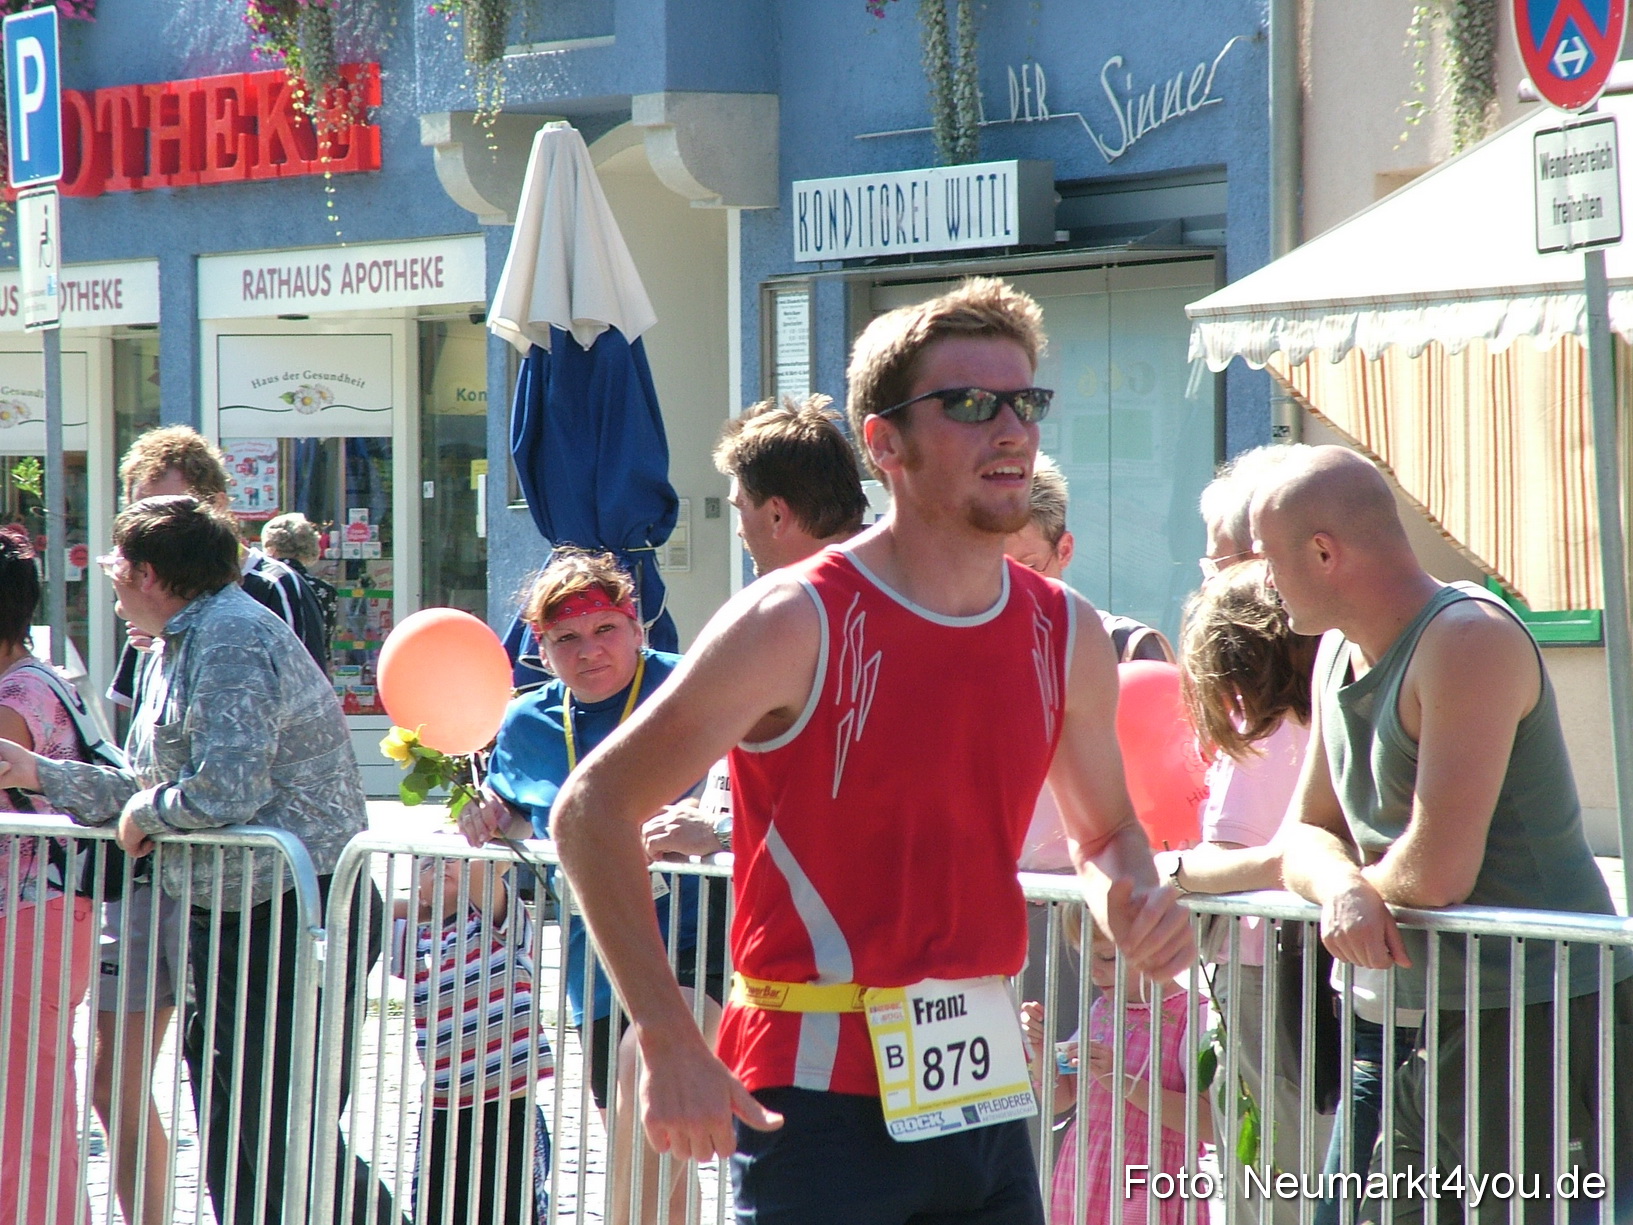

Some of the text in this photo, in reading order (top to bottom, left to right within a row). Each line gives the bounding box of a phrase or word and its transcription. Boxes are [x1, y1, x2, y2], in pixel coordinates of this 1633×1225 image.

[16, 36, 46, 162] P
[1007, 62, 1050, 123] DER
[798, 172, 1010, 254] KONDITOREI WITTL
[243, 255, 444, 301] RATHAUS APOTHEKE
[251, 369, 366, 390] Haus der Gesundheit
[913, 993, 968, 1026] Franz
[886, 1036, 991, 1092] B 879
[977, 1092, 1034, 1116] PFLEIDERER
